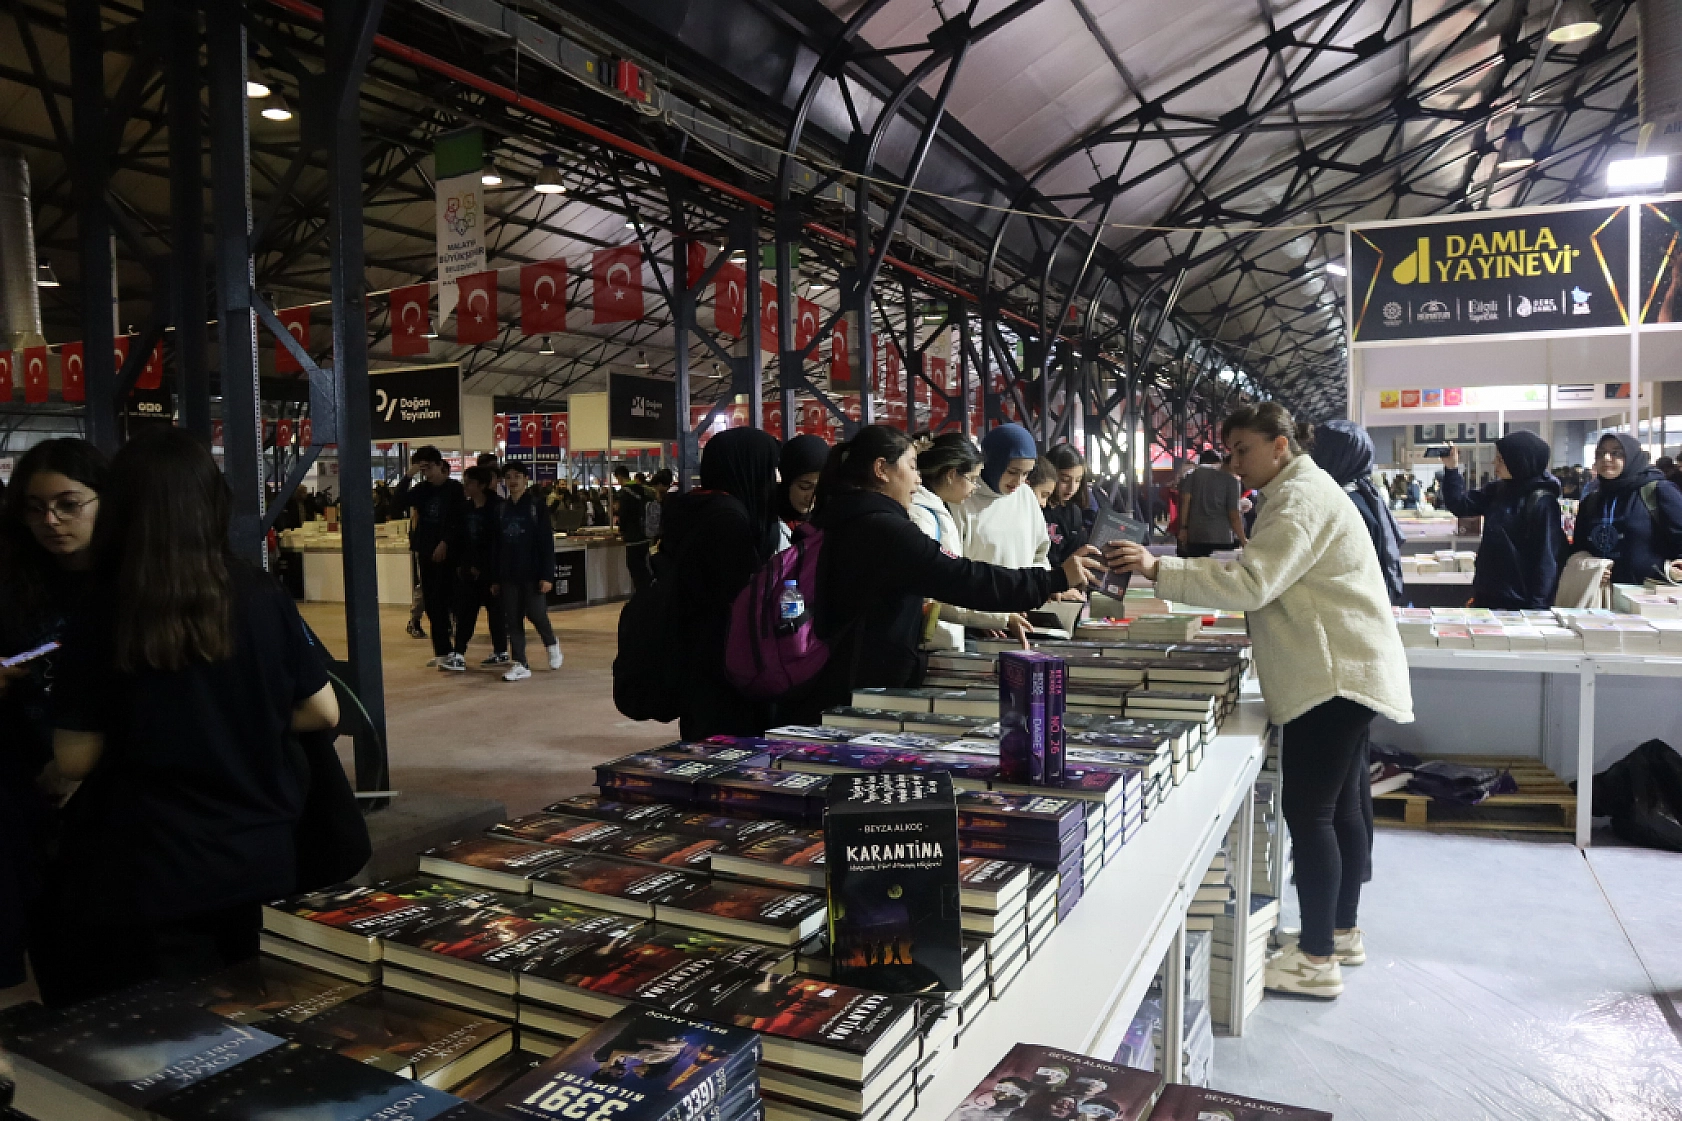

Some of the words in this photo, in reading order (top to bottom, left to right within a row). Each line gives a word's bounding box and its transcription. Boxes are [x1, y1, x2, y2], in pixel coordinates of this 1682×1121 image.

[1445, 227, 1558, 258] DAMLA
[1435, 244, 1572, 283] YAYINEVİ
[400, 396, 431, 410] Doğan
[1050, 715, 1060, 736] NO.
[1050, 740, 1060, 754] 26
[864, 824, 893, 833] BEYZA
[894, 822, 923, 833] ALKOÇ
[846, 839, 944, 862] KARANTİNA
[176, 1052, 240, 1082] SOKAK
[1048, 1052, 1082, 1065] BEYZA
[1204, 1093, 1240, 1107] BEYZA
